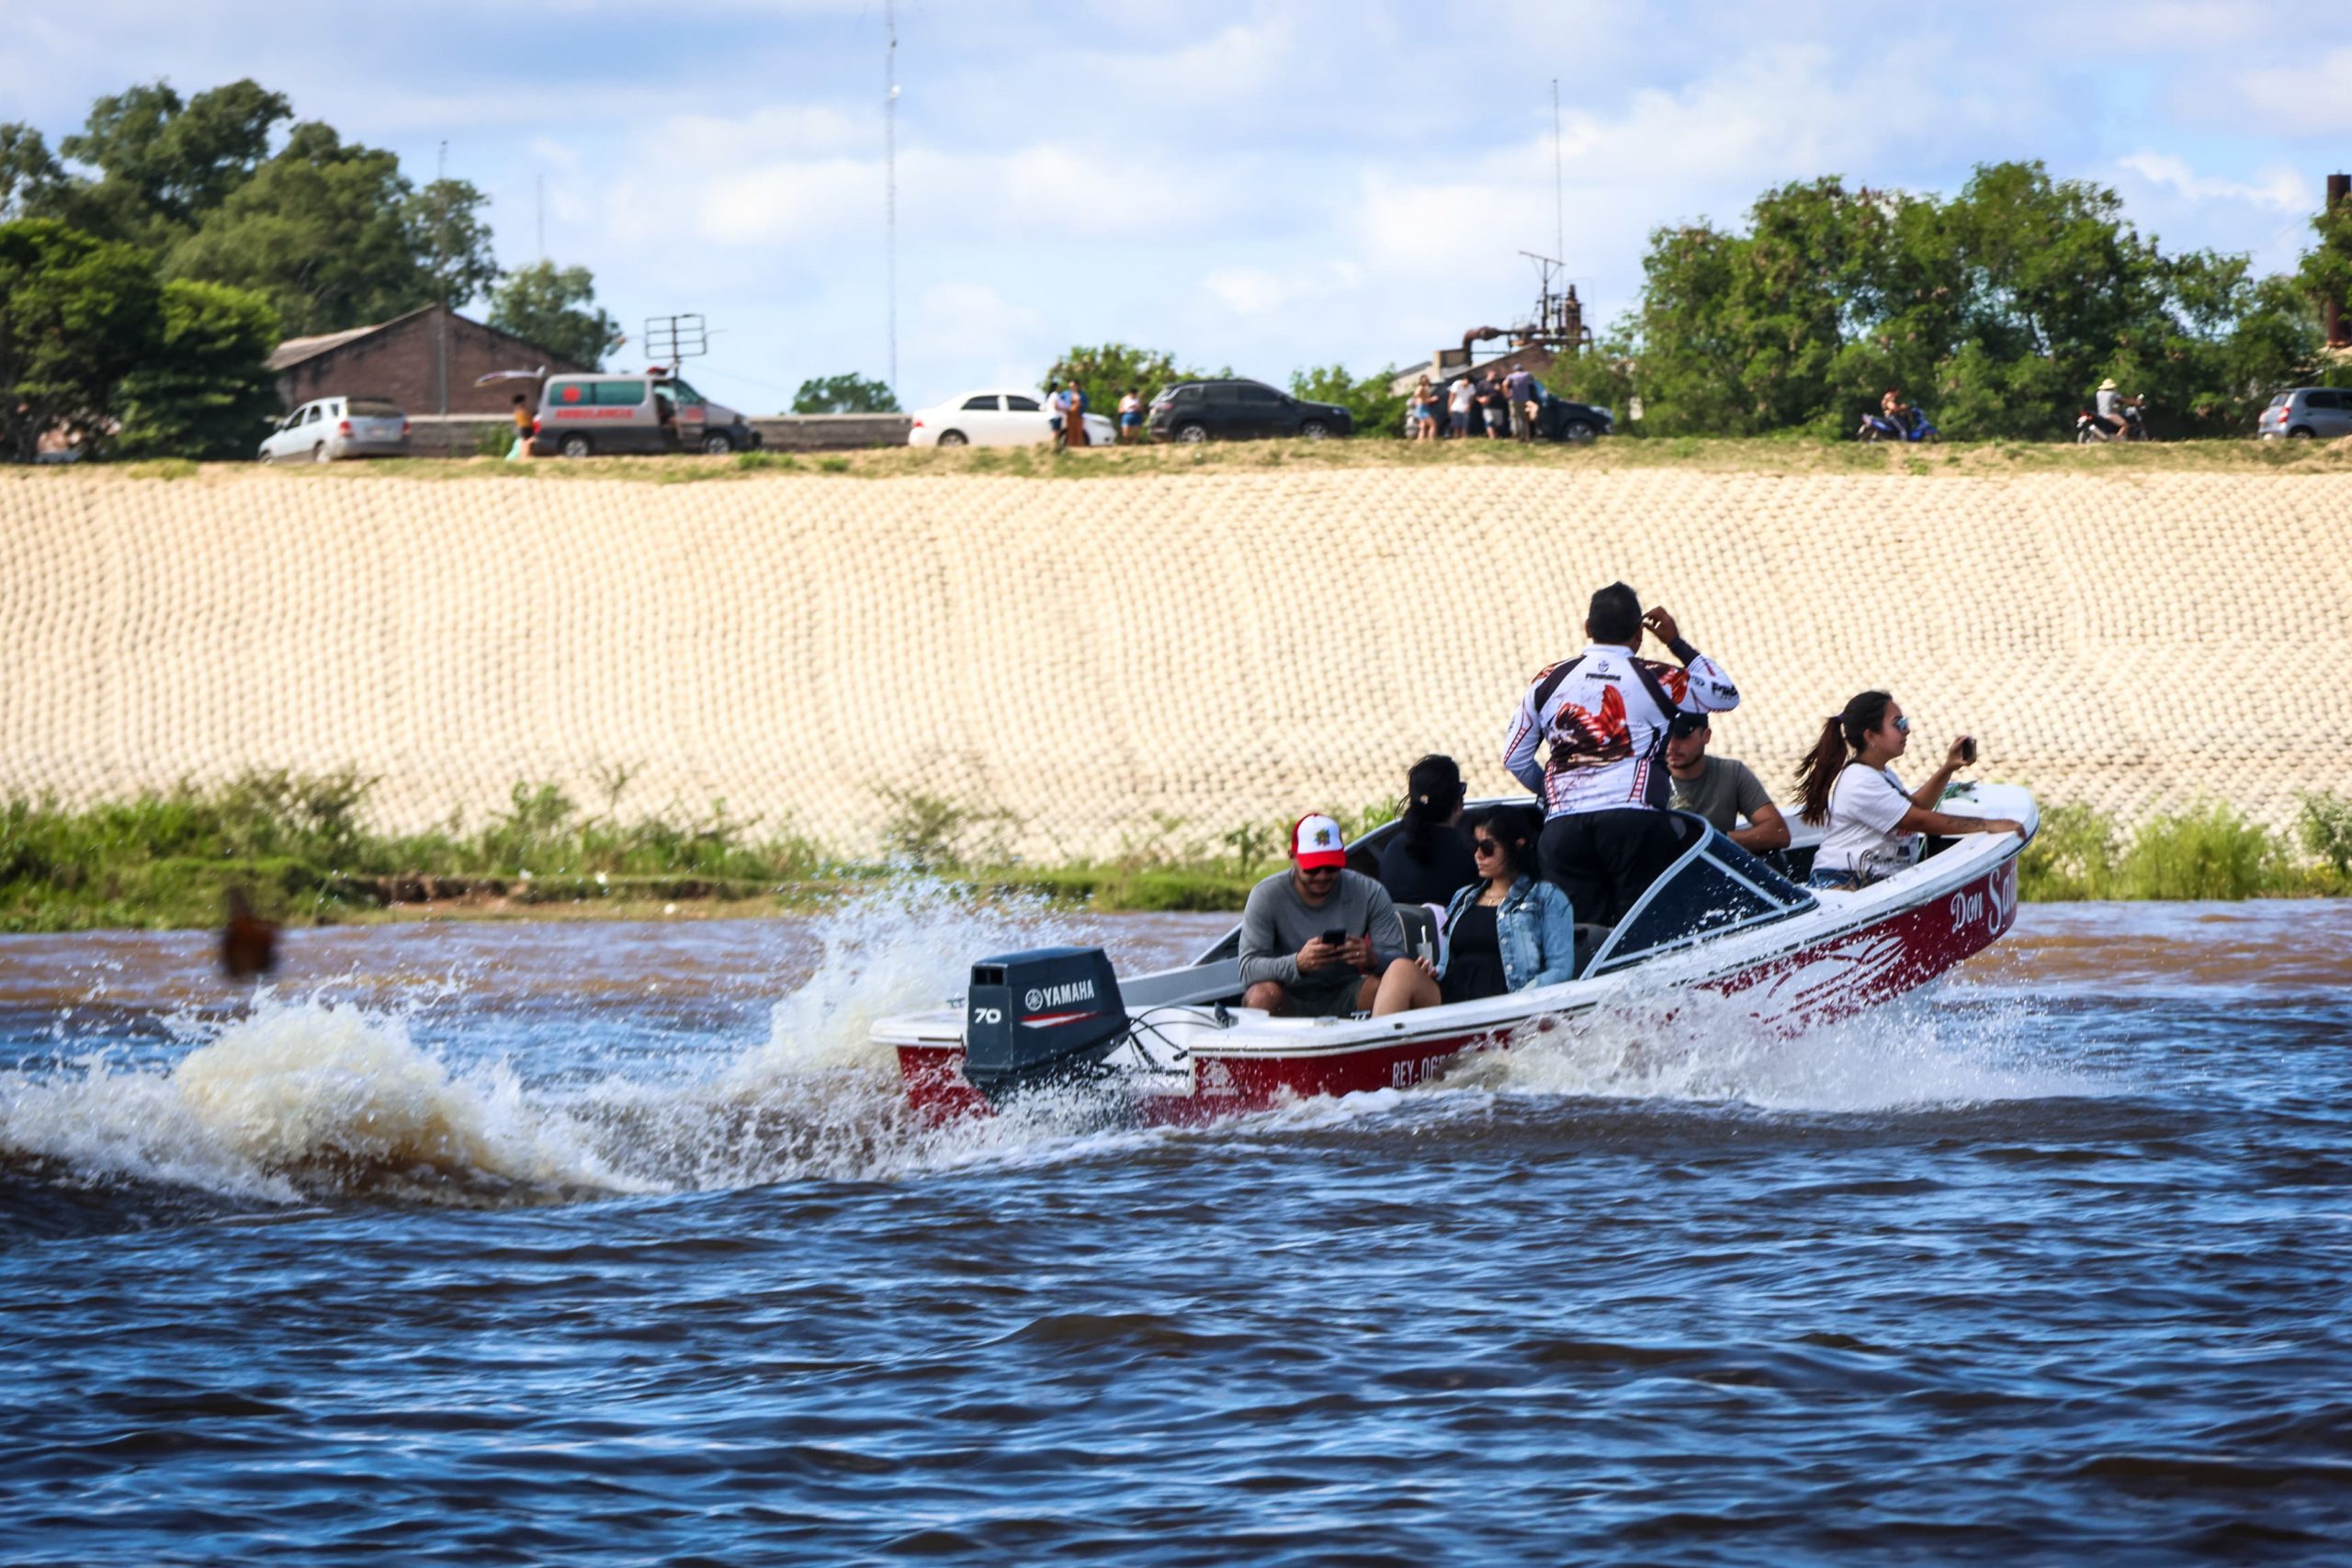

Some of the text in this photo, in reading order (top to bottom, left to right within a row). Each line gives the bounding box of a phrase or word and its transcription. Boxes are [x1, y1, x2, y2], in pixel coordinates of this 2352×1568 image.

[1951, 888, 1983, 934] Don
[1043, 979, 1095, 1007] YAMAHA
[975, 1008, 1001, 1024] 70
